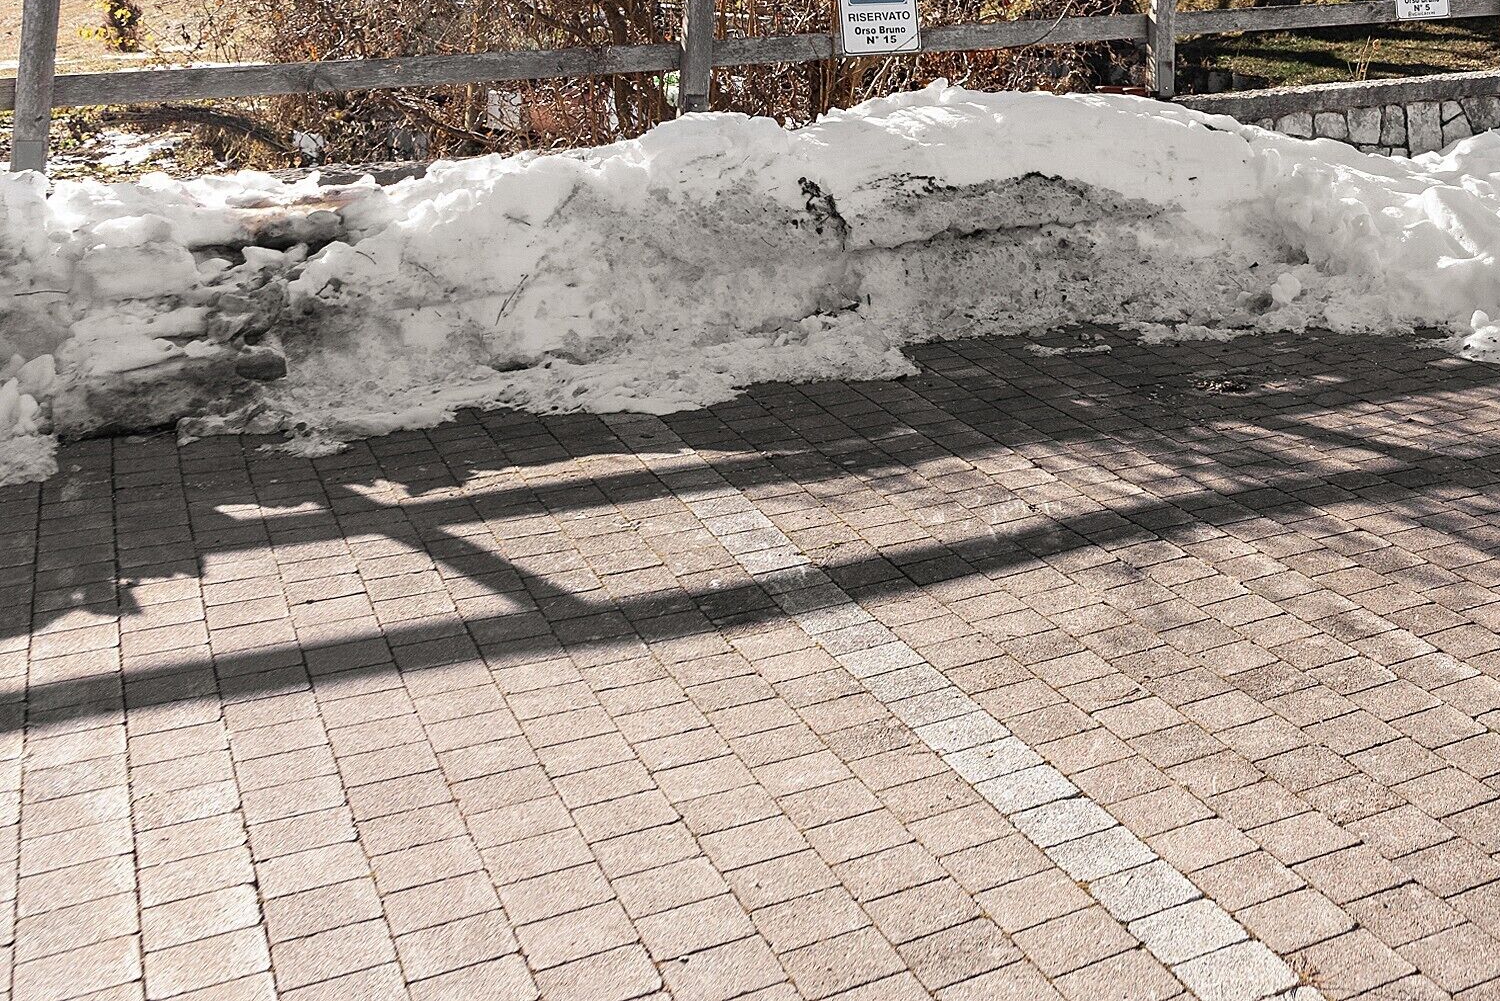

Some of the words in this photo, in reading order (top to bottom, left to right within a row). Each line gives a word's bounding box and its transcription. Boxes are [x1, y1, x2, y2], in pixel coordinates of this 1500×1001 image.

[848, 11, 910, 22] RISERVATO
[854, 26, 876, 35] Orso
[879, 26, 906, 34] Bruno
[884, 35, 897, 44] 15
